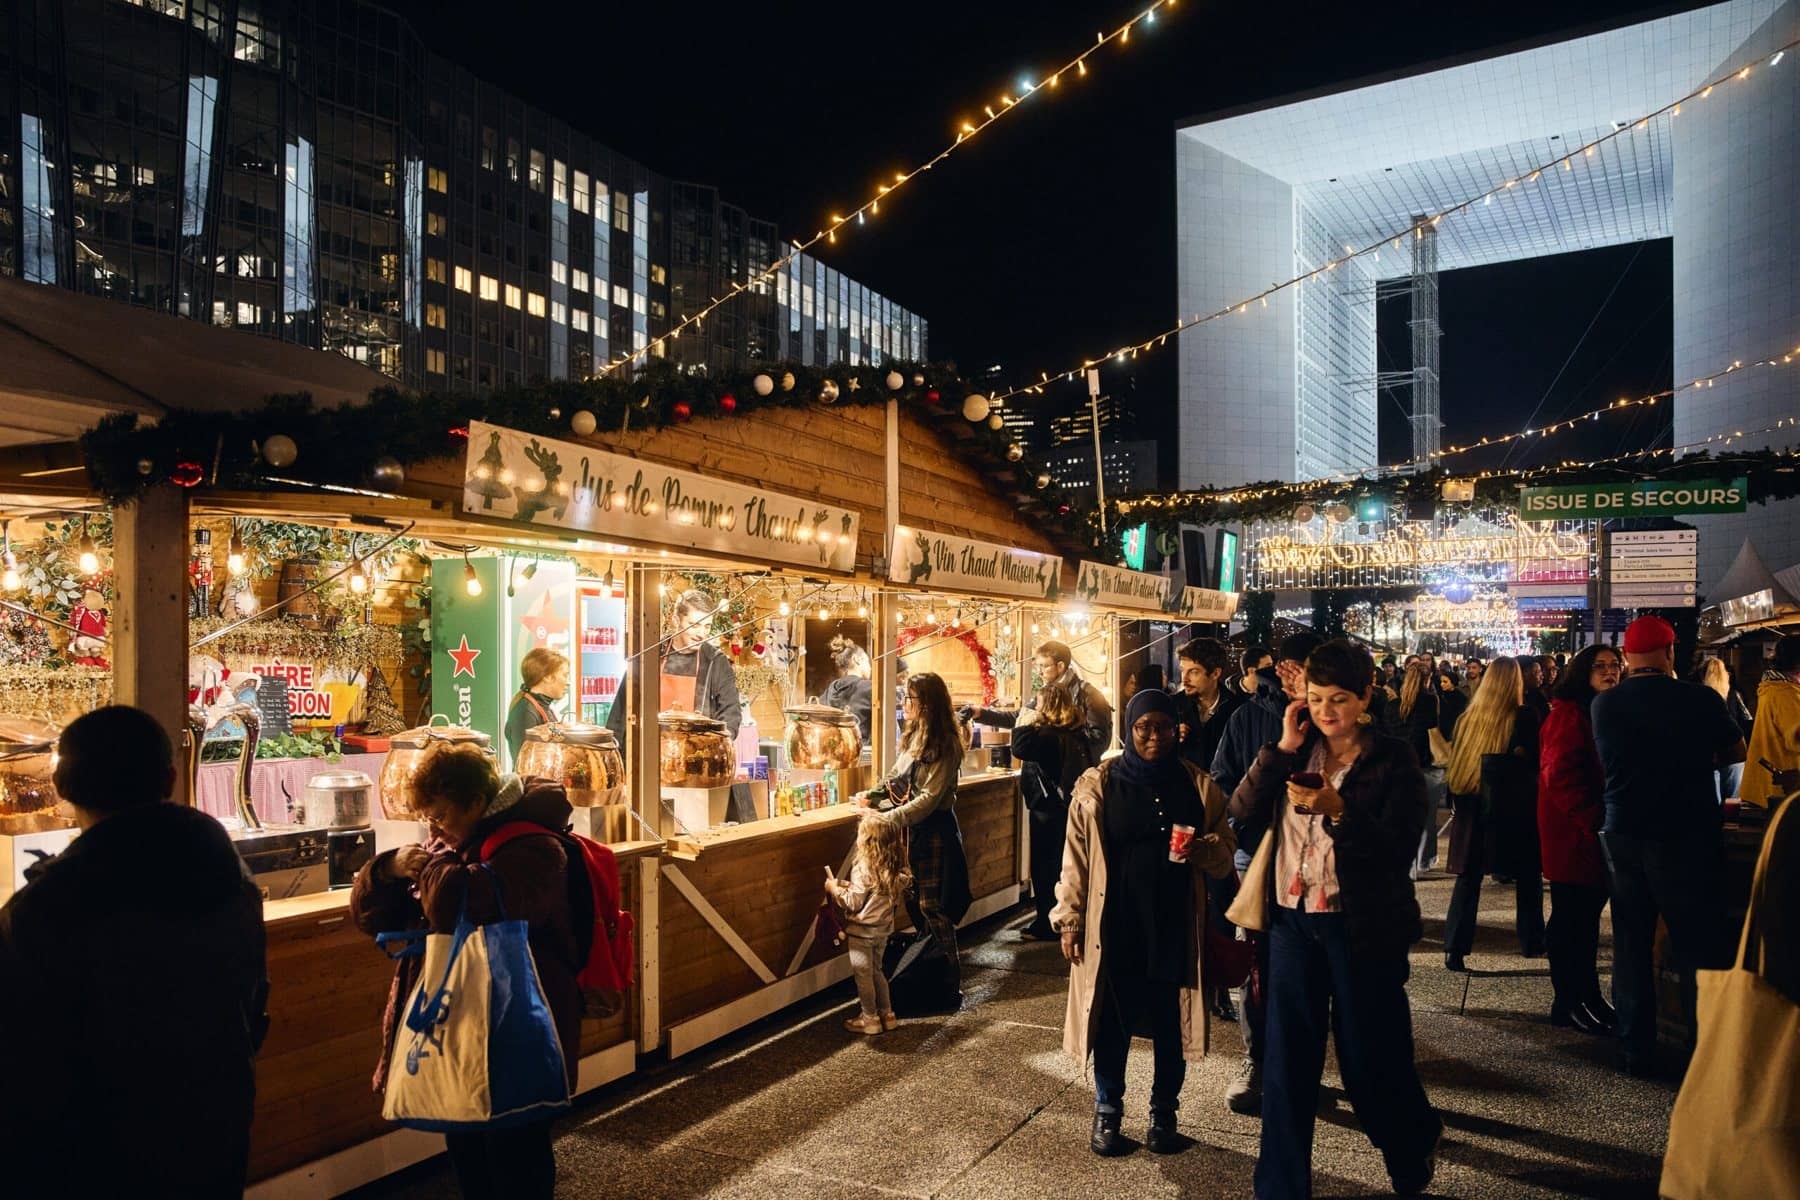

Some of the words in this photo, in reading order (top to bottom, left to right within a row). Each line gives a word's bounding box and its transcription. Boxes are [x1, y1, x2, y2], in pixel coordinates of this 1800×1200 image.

[573, 456, 615, 512] Jus
[625, 469, 651, 517] de
[662, 476, 736, 532] Pomme
[744, 496, 806, 544] Chaud
[1526, 493, 1587, 511] ISSUE
[1594, 492, 1624, 508] DE
[1631, 488, 1740, 506] SECOURS
[933, 539, 957, 573] Vin
[961, 545, 998, 579] Chaud
[1001, 552, 1037, 584] Maison
